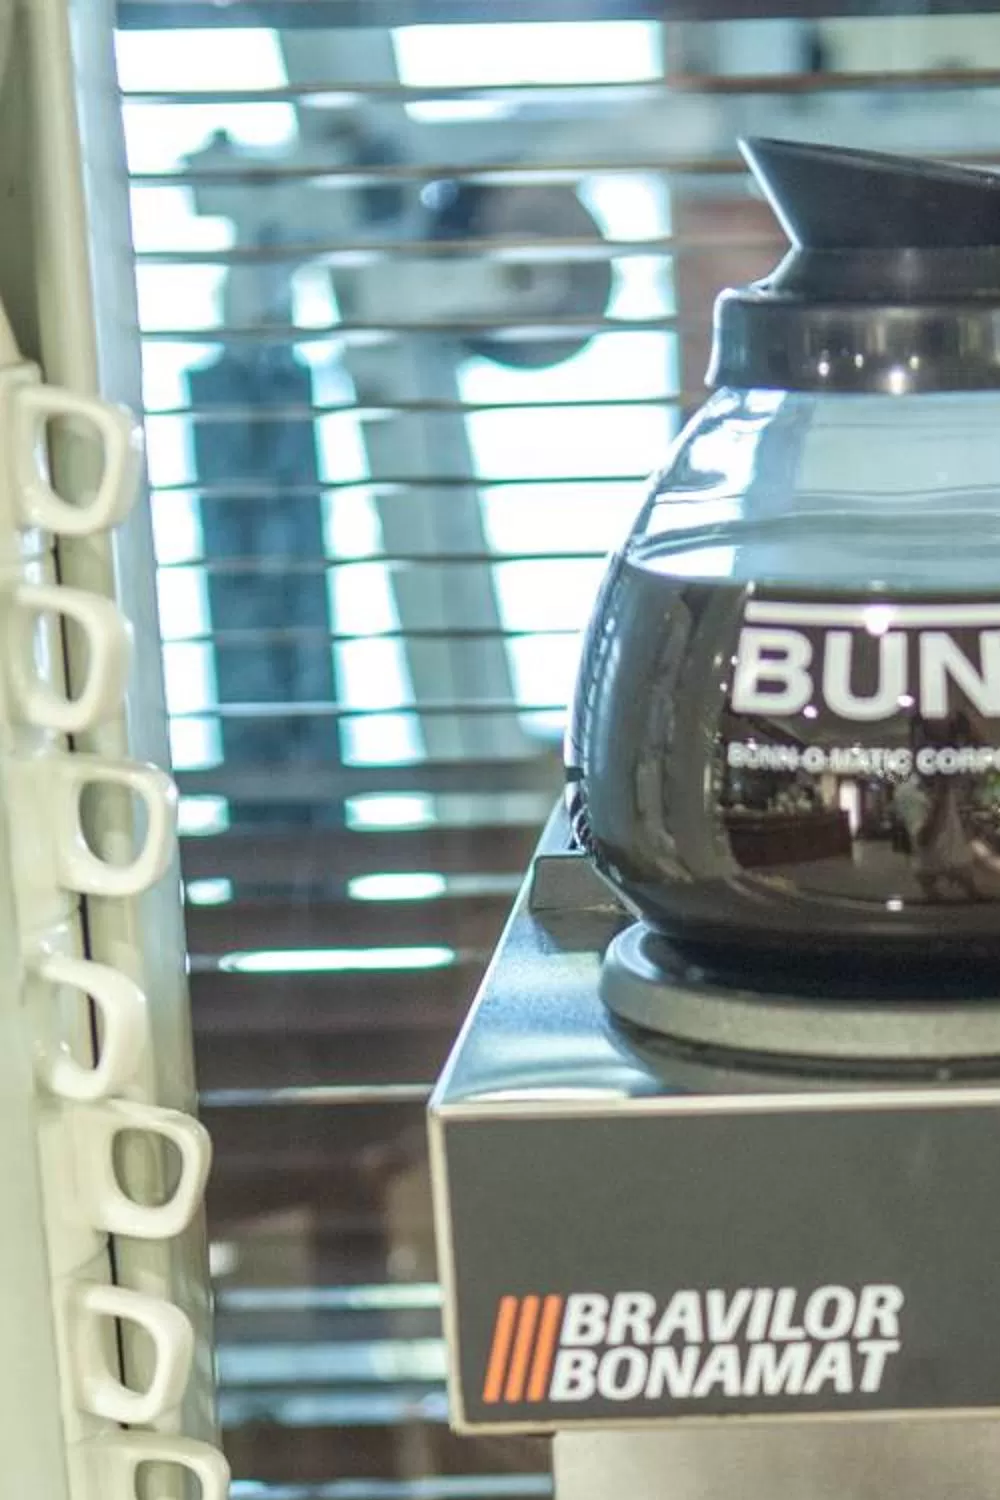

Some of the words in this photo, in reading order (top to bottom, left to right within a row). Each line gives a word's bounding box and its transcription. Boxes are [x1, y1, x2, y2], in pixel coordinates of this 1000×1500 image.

[727, 740, 912, 775] BUNN-O-MATIC
[560, 1283, 904, 1347] BRAVILOR
[549, 1339, 901, 1402] BONAMAT
